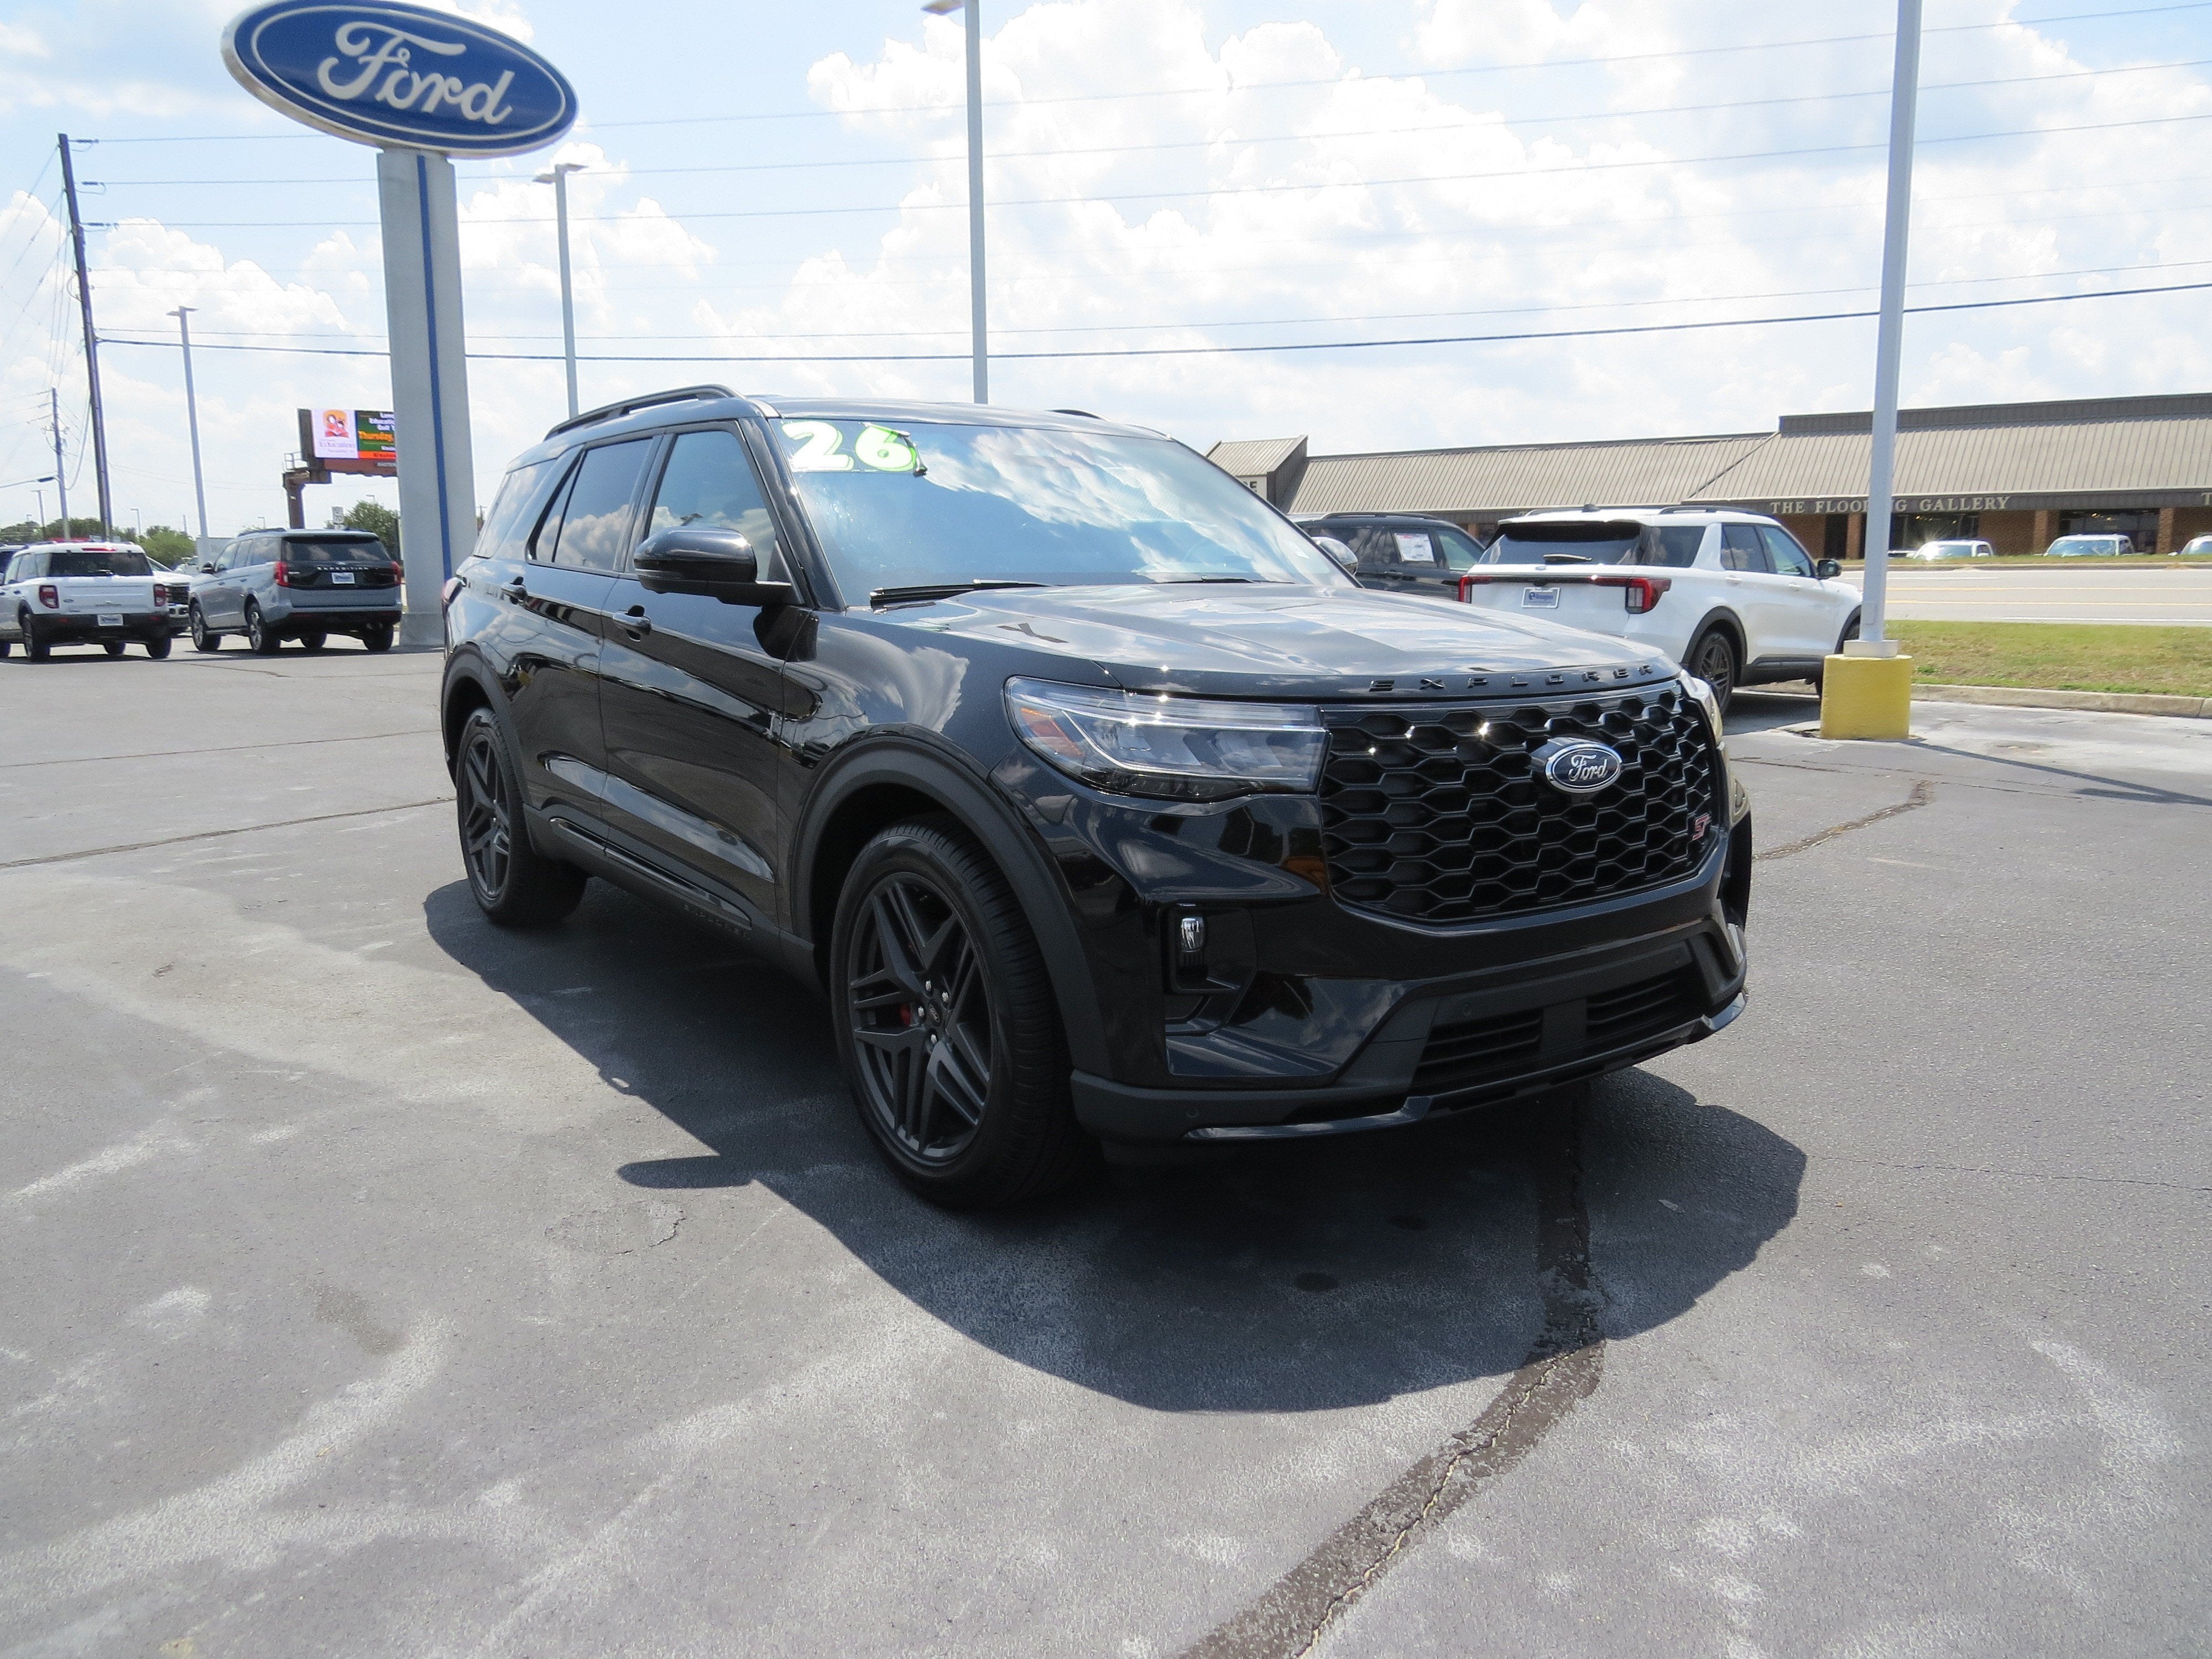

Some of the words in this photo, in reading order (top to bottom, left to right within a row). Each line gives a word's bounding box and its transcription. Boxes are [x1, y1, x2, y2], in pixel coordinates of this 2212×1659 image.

[317, 22, 515, 124] Ford
[781, 420, 918, 472] 26
[1770, 501, 1805, 514] THE
[1814, 499, 1908, 513] FLOOG
[1919, 496, 2011, 512] GALLERY
[1368, 664, 1653, 692] EXPLORER
[1568, 754, 1608, 782] Ford
